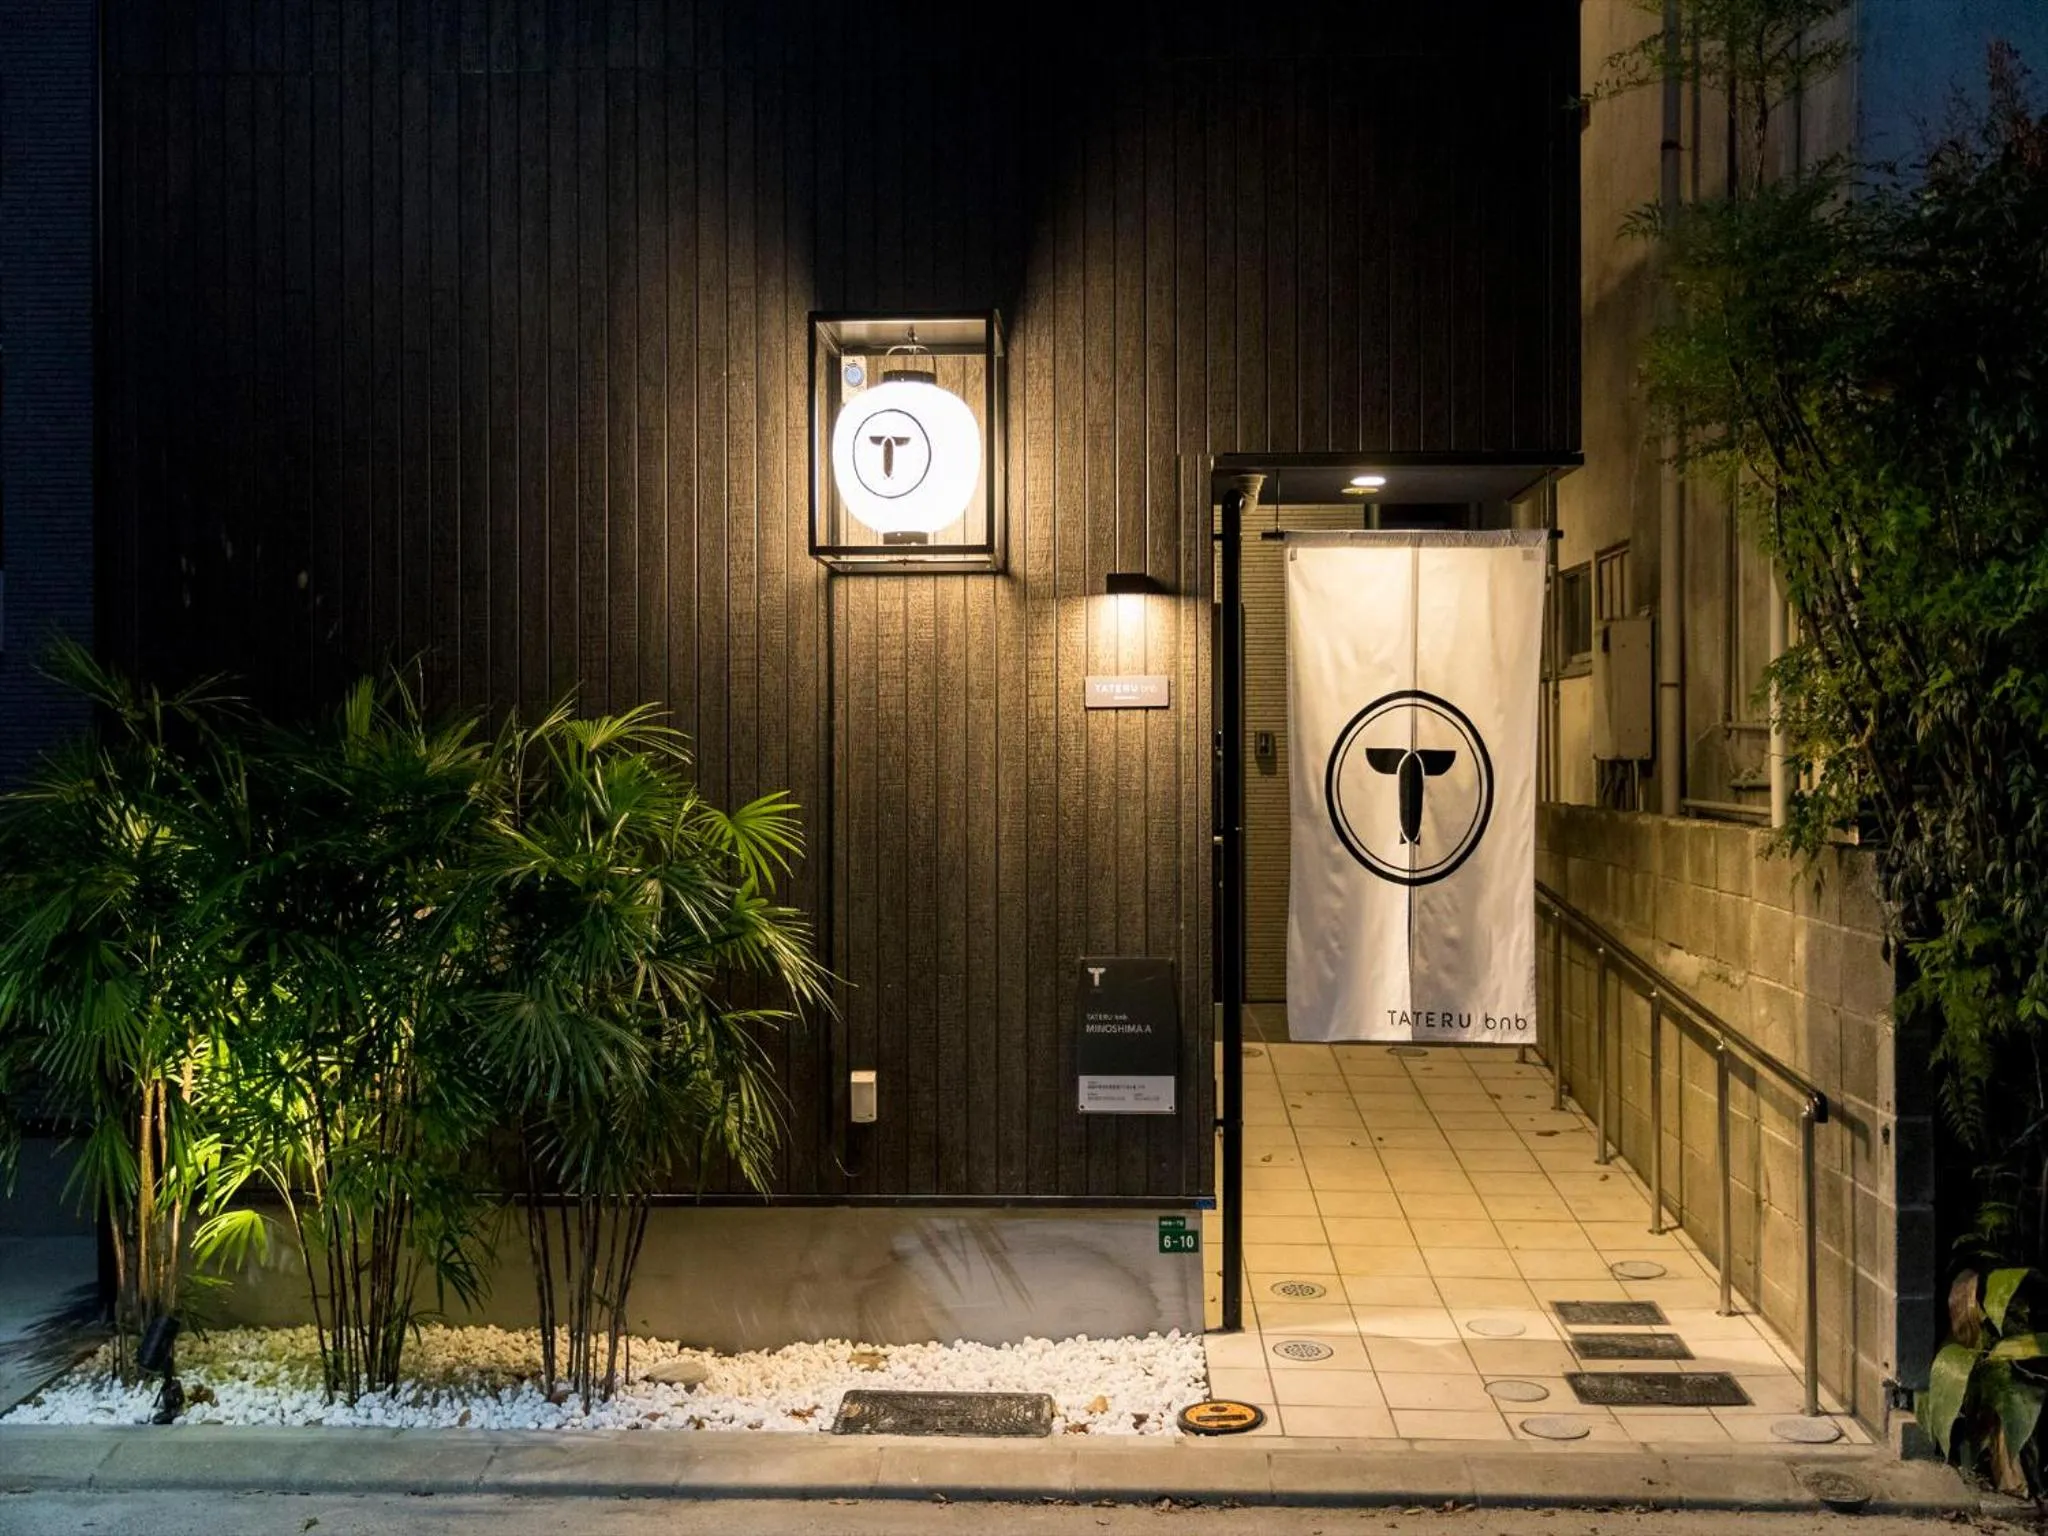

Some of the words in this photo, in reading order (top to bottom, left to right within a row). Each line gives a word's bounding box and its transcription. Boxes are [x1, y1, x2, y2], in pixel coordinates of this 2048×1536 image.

[1387, 1010, 1471, 1029] TATERU
[1484, 1012, 1528, 1031] bnb
[1163, 1235, 1195, 1249] 6-10
